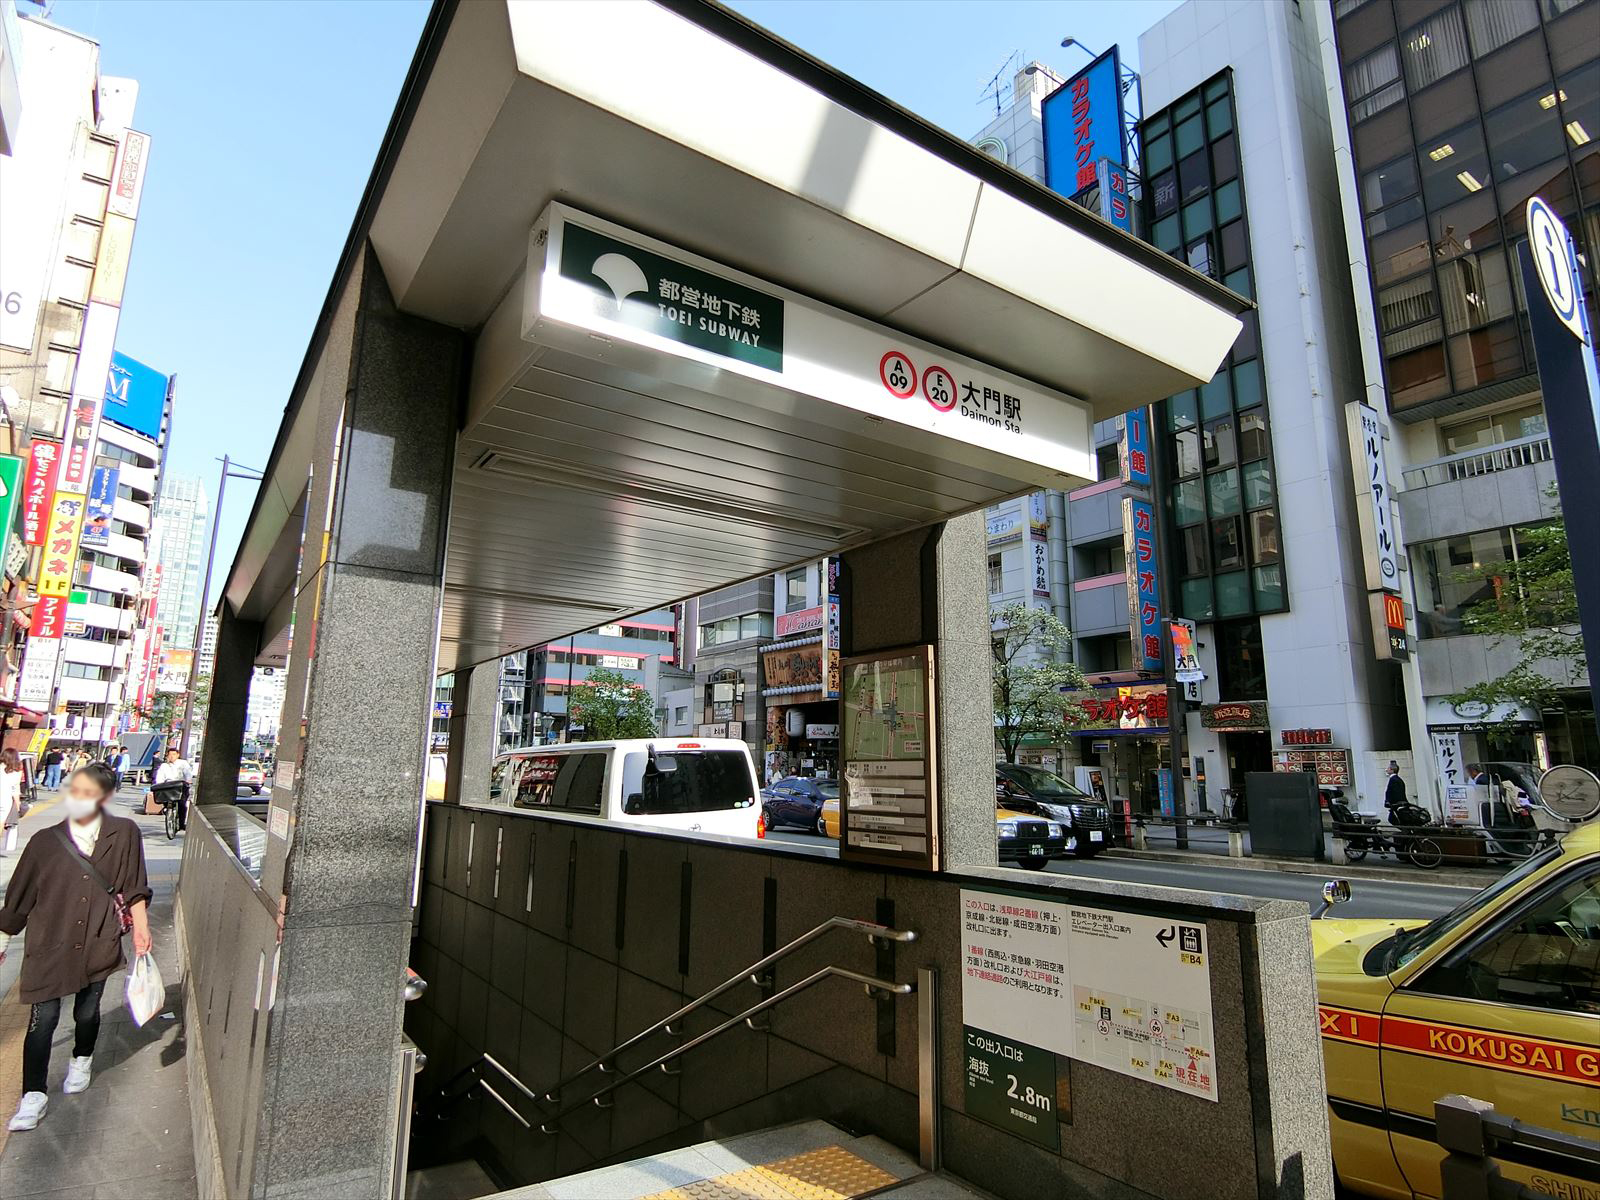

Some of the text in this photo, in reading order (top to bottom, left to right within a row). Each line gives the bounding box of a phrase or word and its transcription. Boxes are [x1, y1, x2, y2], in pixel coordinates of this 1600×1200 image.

[1071, 75, 1098, 192] カラオケ館
[1154, 182, 1175, 207] 新
[658, 277, 761, 330] 都営地下鉄
[657, 303, 761, 348] TOEI SUBWAY
[894, 359, 904, 374] A
[889, 373, 908, 390] 09
[936, 373, 943, 388] E
[931, 386, 949, 404] 20
[961, 380, 1022, 422] 大門駅
[961, 404, 1023, 436] Daimon Sta.
[1367, 436, 1391, 553] ルノアール
[47, 520, 75, 576] メガネ
[1135, 509, 1161, 660] カラオケ館
[39, 597, 58, 636] アイフル
[1177, 654, 1197, 669] 大門
[163, 671, 188, 683] 大門
[1063, 693, 1168, 722] ラオケ館
[1189, 954, 1202, 965] B4
[1152, 1024, 1161, 1033] 09
[1171, 1014, 1180, 1022] A3
[967, 1033, 1024, 1062] この出入口は
[1429, 1029, 1563, 1072] KOKUSAI
[1576, 1053, 1600, 1077] G
[968, 1056, 989, 1077] 海抜
[1136, 1060, 1144, 1068] A2
[1159, 1070, 1168, 1078] A4
[1164, 1061, 1173, 1070] A5
[1176, 1066, 1210, 1086] 現在地
[1007, 1074, 1050, 1111] 2.8m
